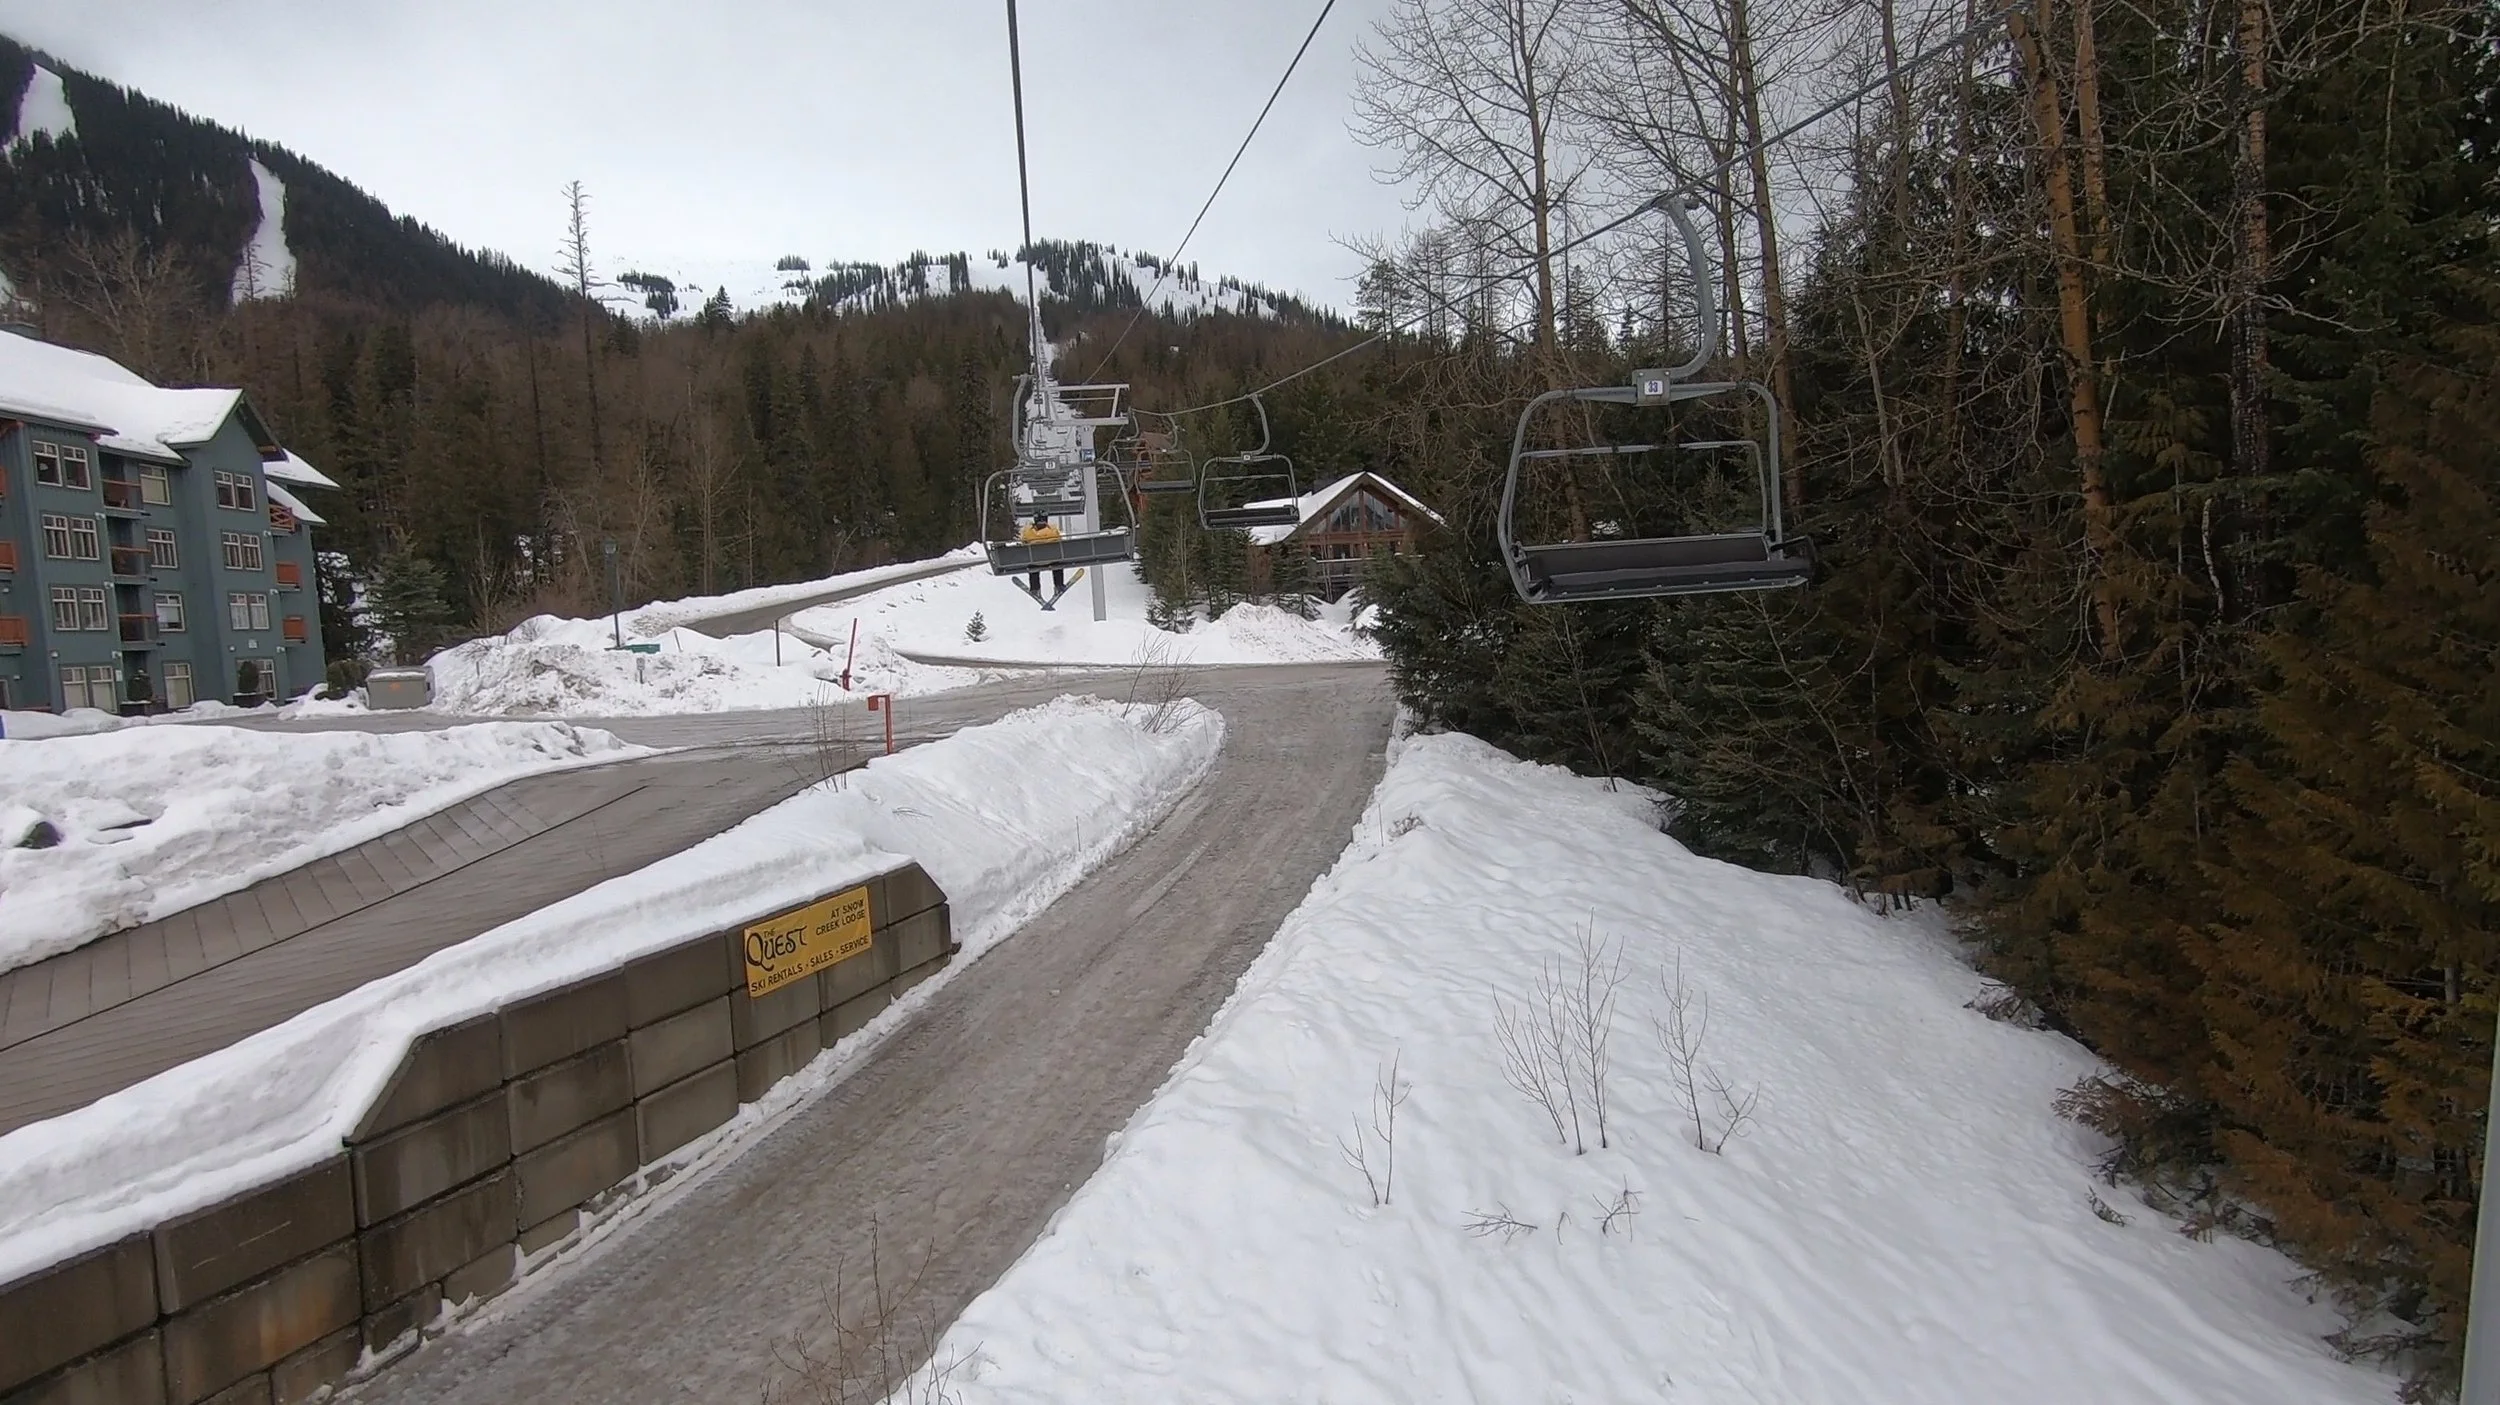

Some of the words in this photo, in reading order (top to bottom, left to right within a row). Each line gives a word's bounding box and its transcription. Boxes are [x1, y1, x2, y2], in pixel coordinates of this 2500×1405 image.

[815, 919, 840, 936] CREEK
[841, 909, 866, 926] LODGE
[830, 908, 840, 919] AT
[842, 899, 865, 914] SNOW
[751, 979, 767, 992] SKI
[768, 963, 803, 985] RENTALS
[810, 950, 834, 968] SALES
[840, 935, 869, 954] SERVICE
